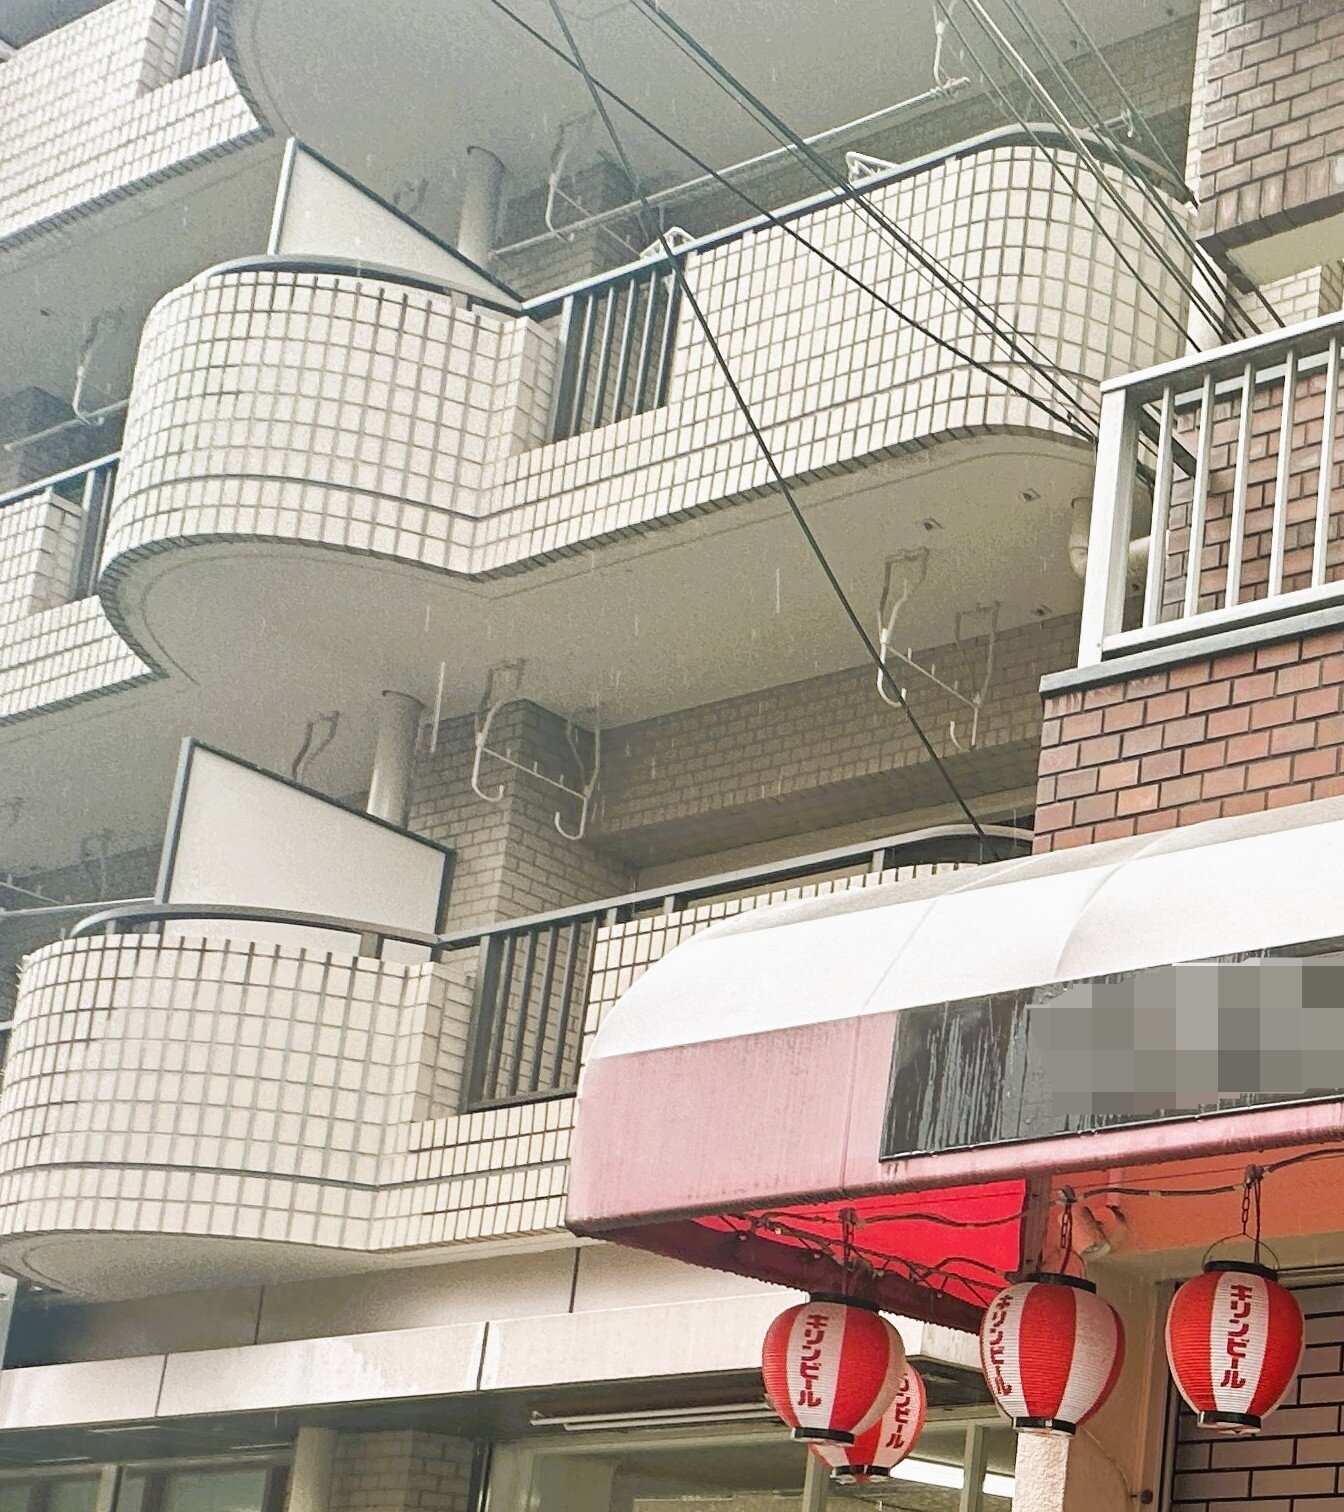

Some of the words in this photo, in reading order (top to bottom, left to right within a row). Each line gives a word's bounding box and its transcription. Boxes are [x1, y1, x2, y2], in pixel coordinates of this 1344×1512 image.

[797, 1313, 830, 1409] キリンビール
[1220, 1283, 1256, 1390] キリンビール
[886, 1372, 911, 1449] リンビール
